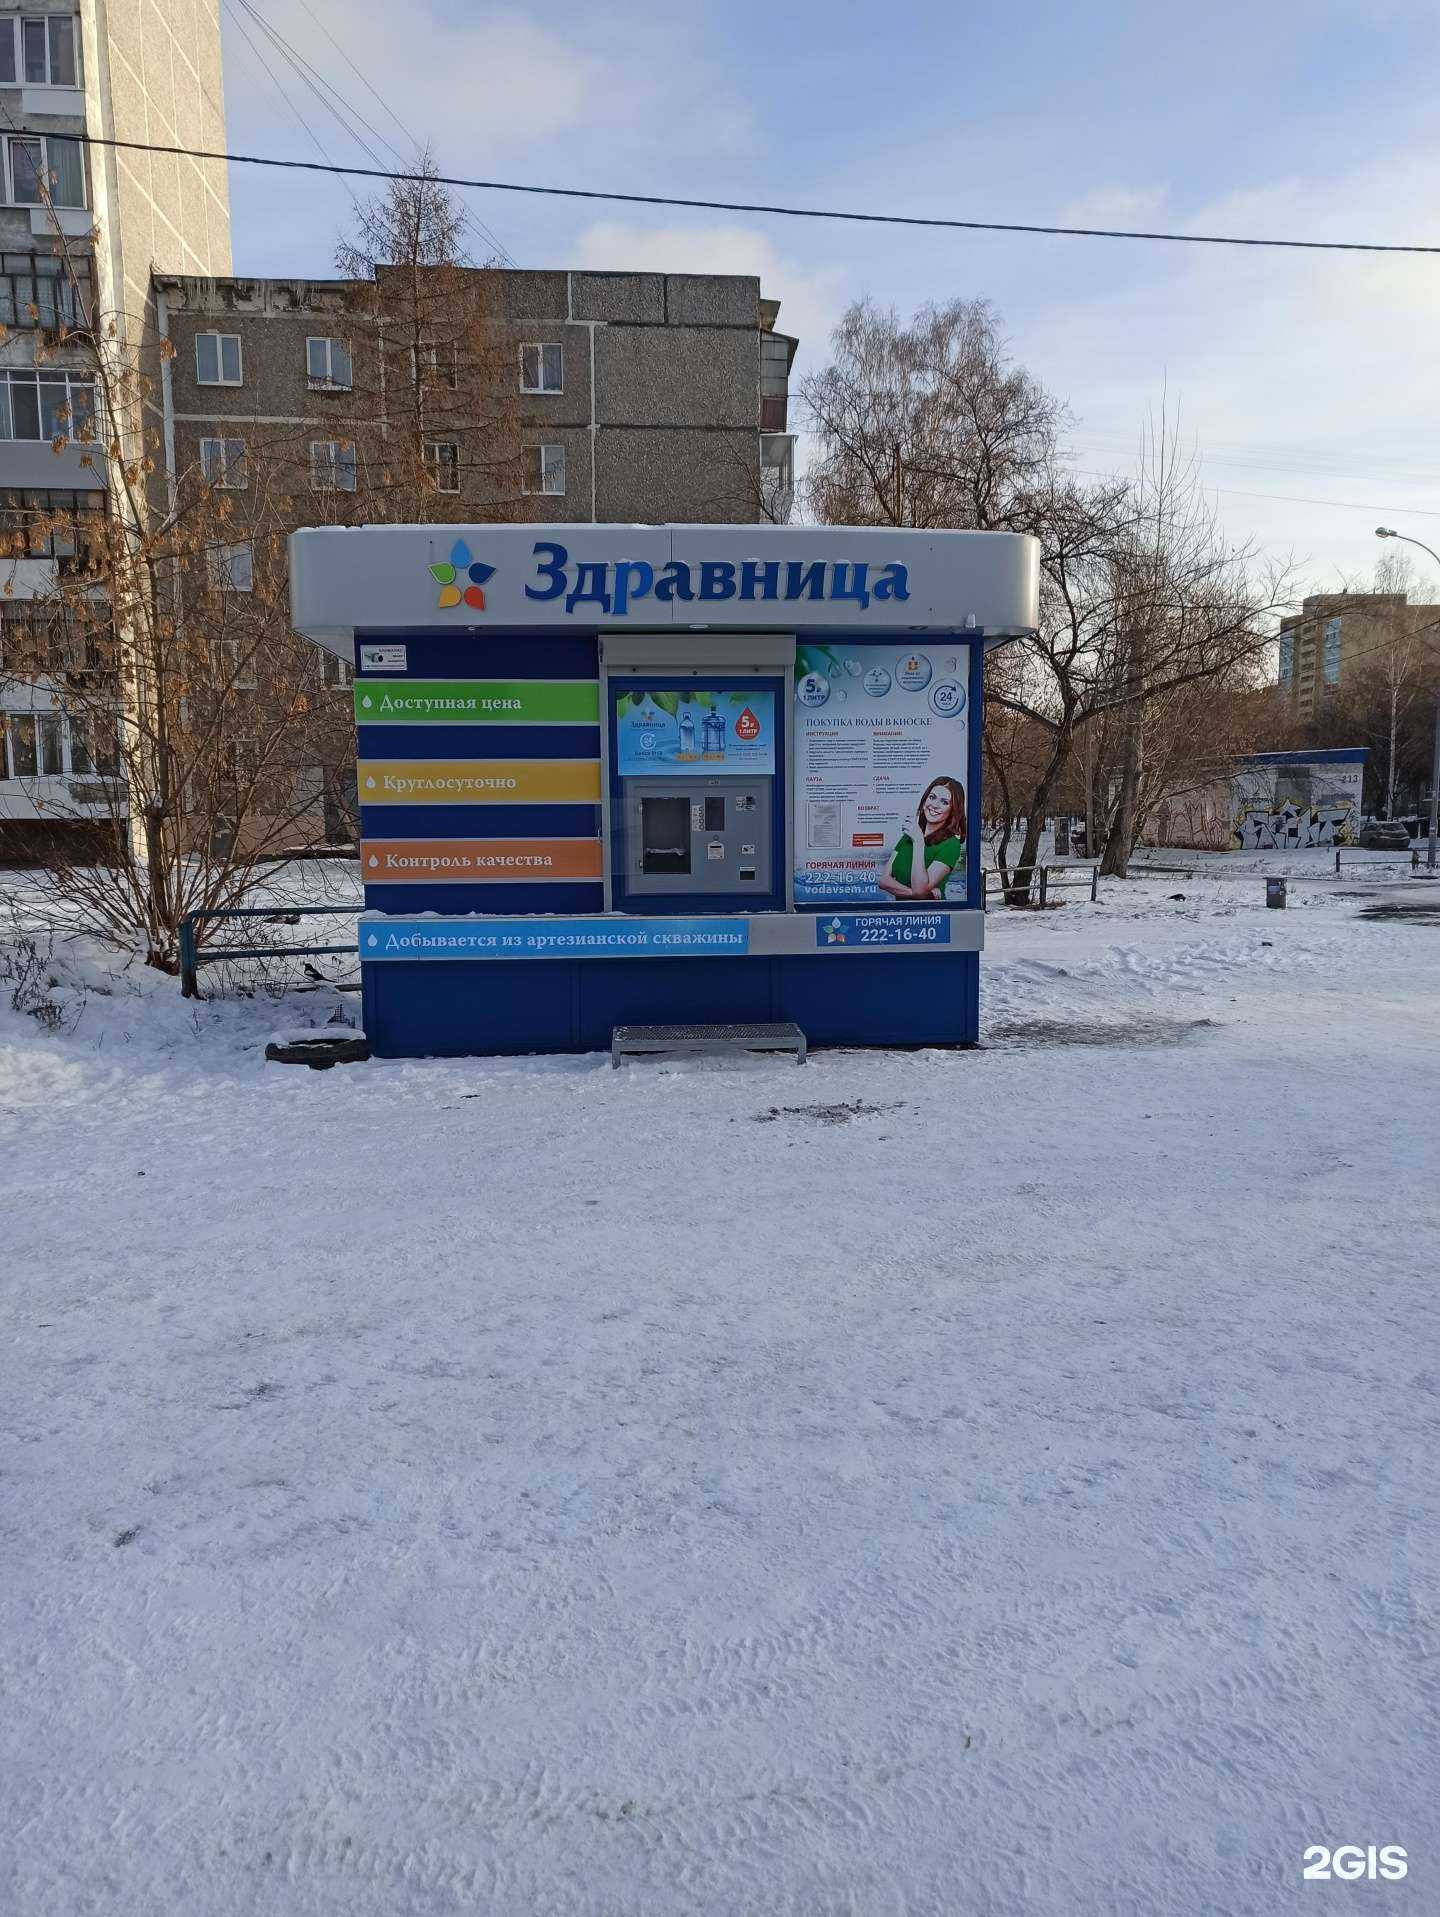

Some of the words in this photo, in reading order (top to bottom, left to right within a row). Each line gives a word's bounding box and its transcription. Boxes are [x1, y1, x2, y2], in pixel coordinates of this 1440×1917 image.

[525, 542, 912, 615] Здравница
[940, 692, 952, 702] 24
[380, 694, 477, 713] Доступная
[481, 698, 522, 712] цена
[806, 718, 853, 727] ПОКУПКА
[855, 718, 883, 727] ВОДЫ
[885, 718, 892, 726] В
[893, 717, 933, 726] КИОСКЕ
[383, 776, 517, 793] Круглосуточно
[1341, 774, 1359, 783] 213
[385, 854, 471, 870] Контроль
[476, 855, 553, 866] качества
[846, 861, 876, 869] ЛИНИЯ
[806, 872, 876, 883] 222-16-40
[805, 885, 877, 895] vodavsem.ru
[855, 917, 902, 927] ГОРЯЧАЯ
[905, 915, 941, 925] ЛИНИЯ
[385, 933, 497, 950] Добывается
[502, 935, 522, 946] из
[527, 931, 648, 949] артезианской
[653, 932, 743, 945] скважины
[860, 927, 937, 942] 222-16-40
